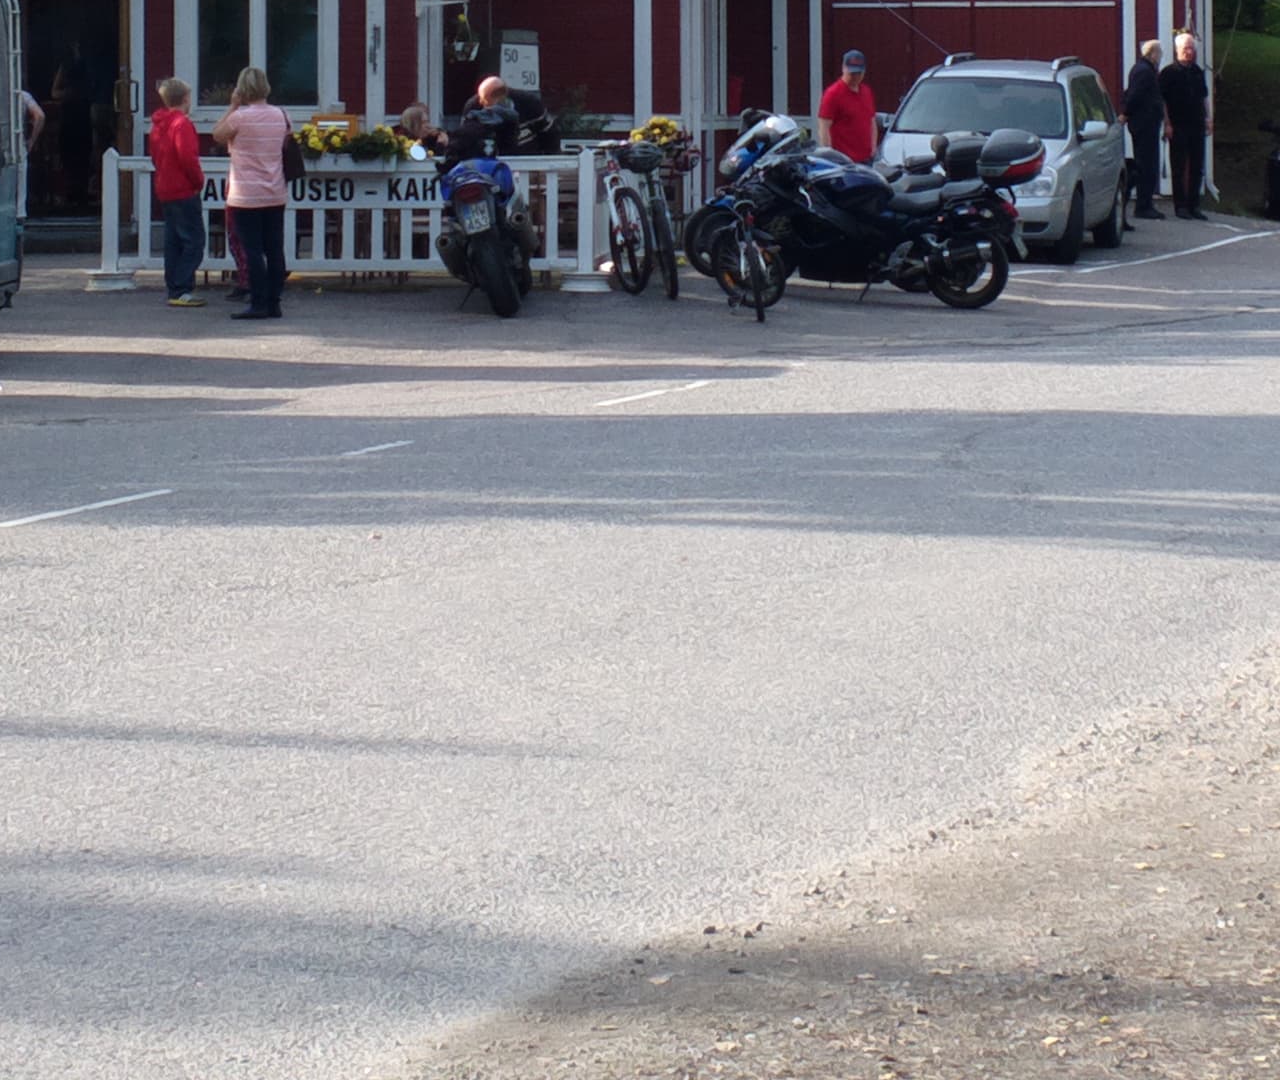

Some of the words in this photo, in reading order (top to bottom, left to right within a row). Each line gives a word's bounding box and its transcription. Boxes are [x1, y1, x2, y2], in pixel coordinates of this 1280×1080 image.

[503, 48, 519, 63] 50
[521, 70, 537, 86] 50
[387, 177, 437, 202] KAH
